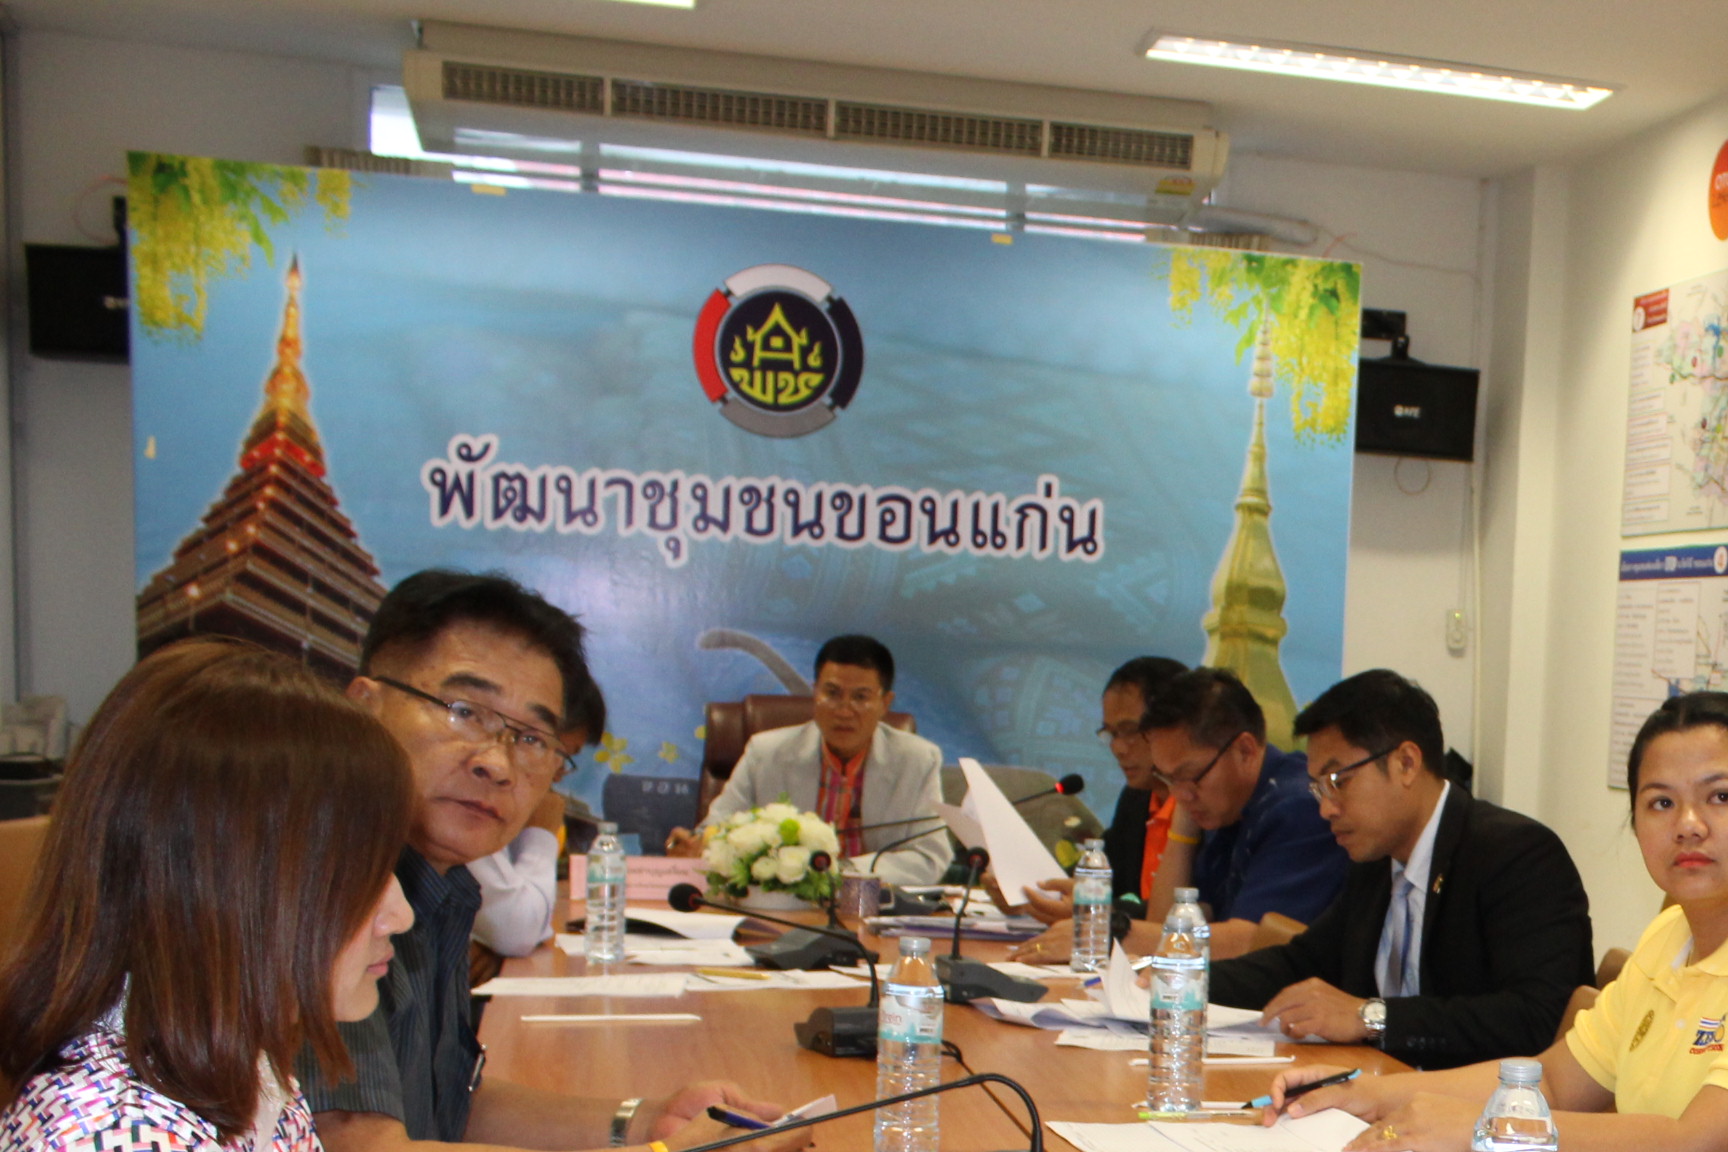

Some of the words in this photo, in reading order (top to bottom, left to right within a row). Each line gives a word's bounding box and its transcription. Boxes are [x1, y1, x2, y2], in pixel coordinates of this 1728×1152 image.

[424, 434, 1104, 568] พัฒนาชุมชนขอนแก่น
